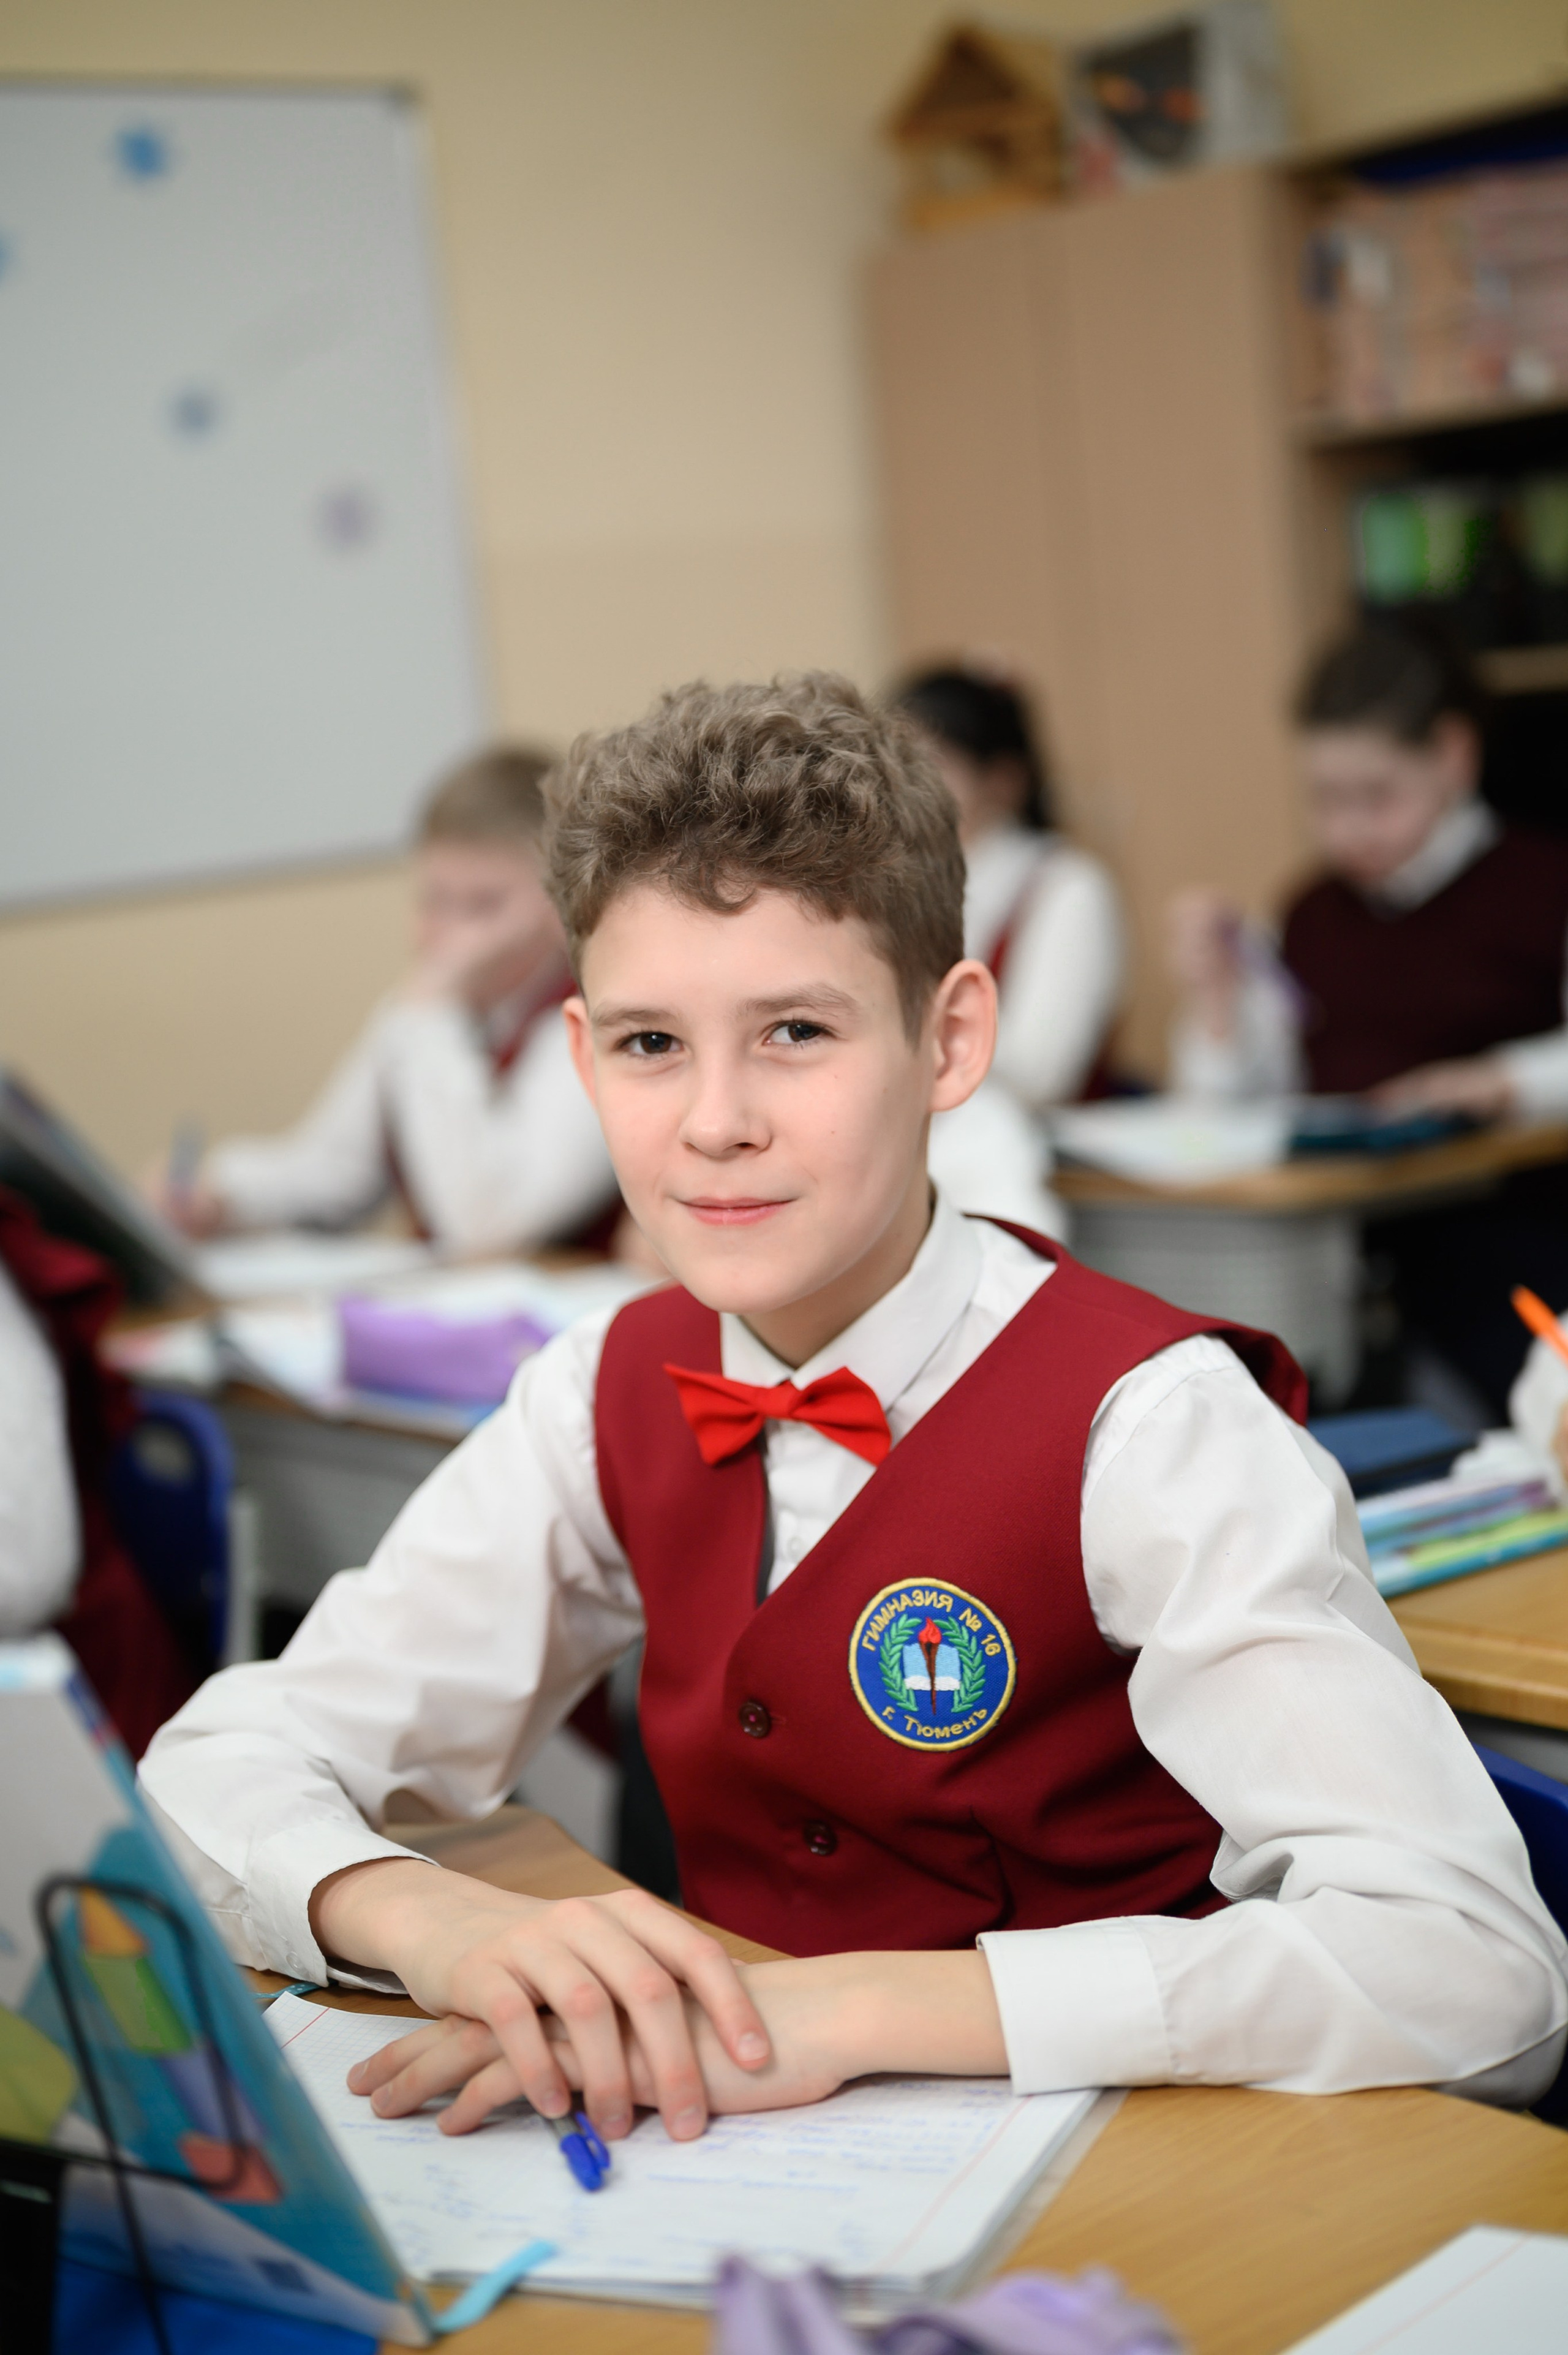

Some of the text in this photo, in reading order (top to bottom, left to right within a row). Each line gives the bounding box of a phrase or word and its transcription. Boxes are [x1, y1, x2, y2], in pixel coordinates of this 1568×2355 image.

[862, 1589, 1001, 1656] ГИМНАЗИЯ № 16
[905, 1708, 987, 1738] Тюмень
